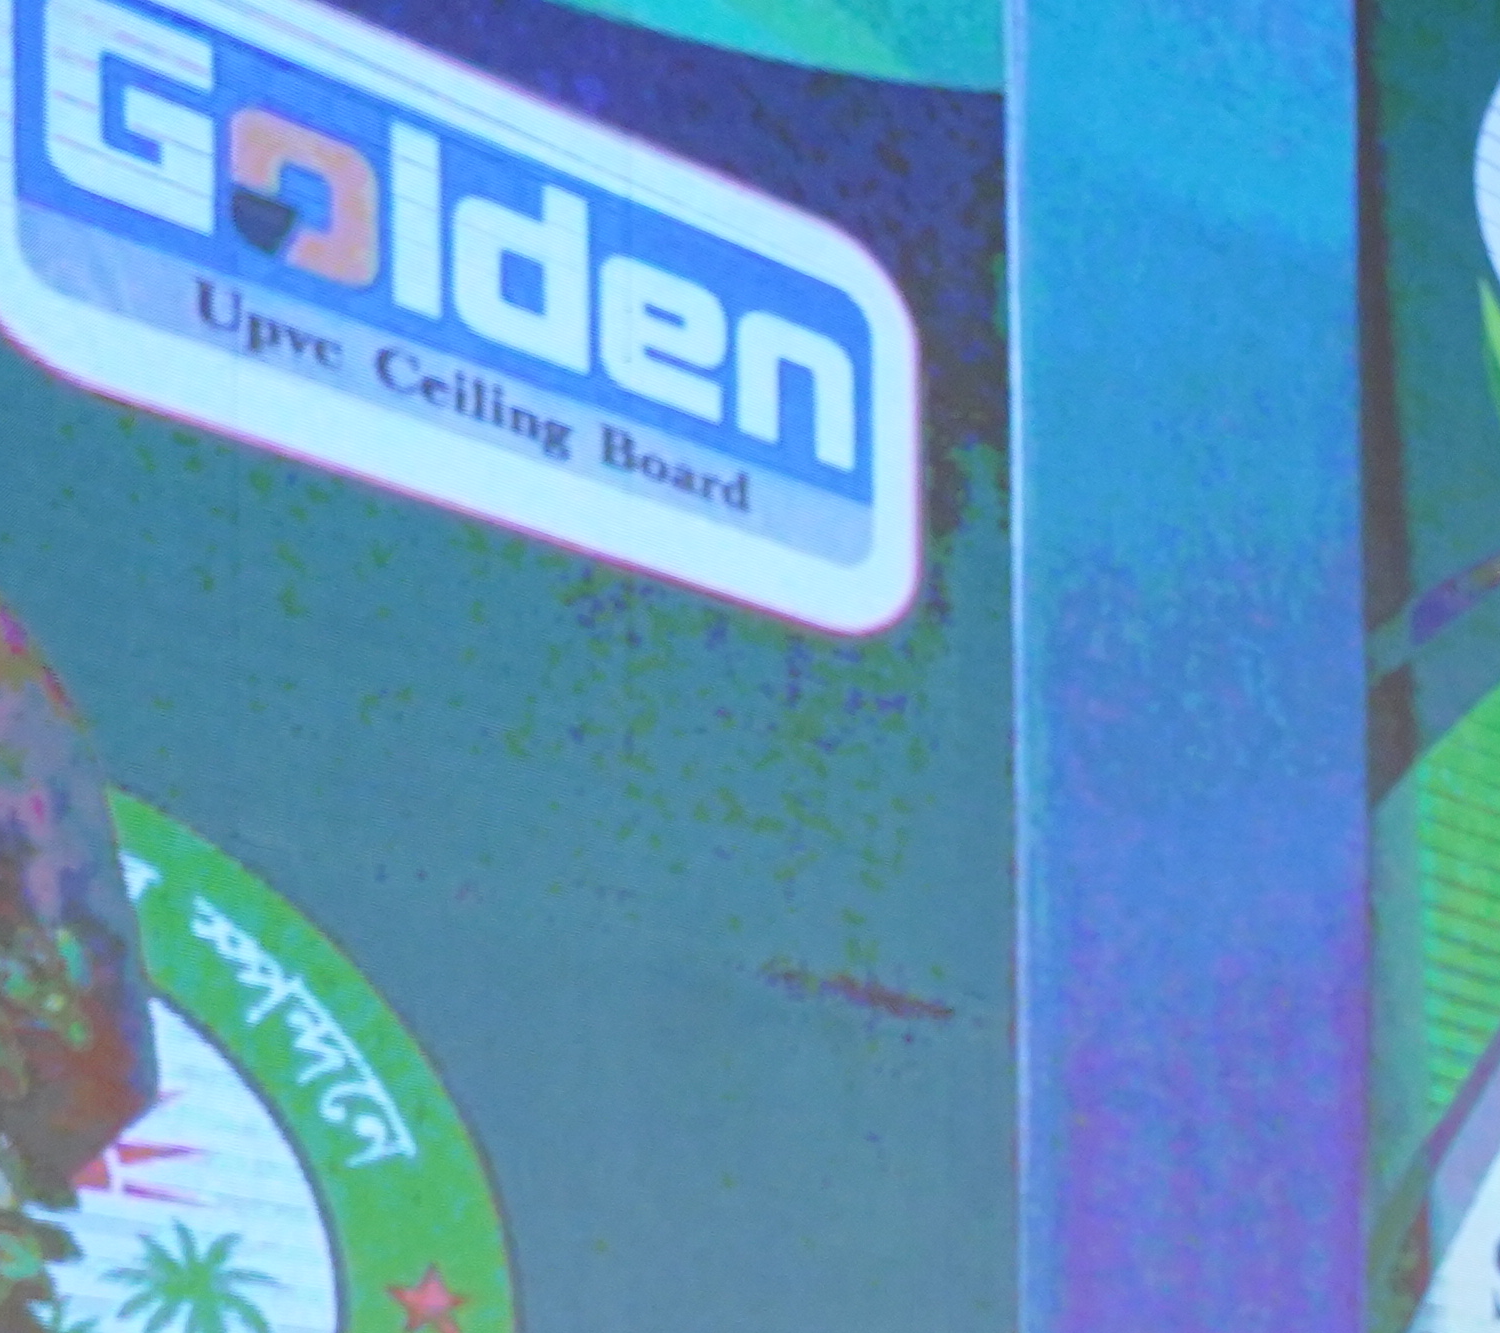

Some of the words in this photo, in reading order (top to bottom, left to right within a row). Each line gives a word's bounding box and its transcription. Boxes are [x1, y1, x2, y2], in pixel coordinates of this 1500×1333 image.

[45, 0, 856, 473] Golden
[194, 275, 344, 371] Upvc
[374, 345, 574, 463] Ceiling
[601, 422, 752, 514] Board
